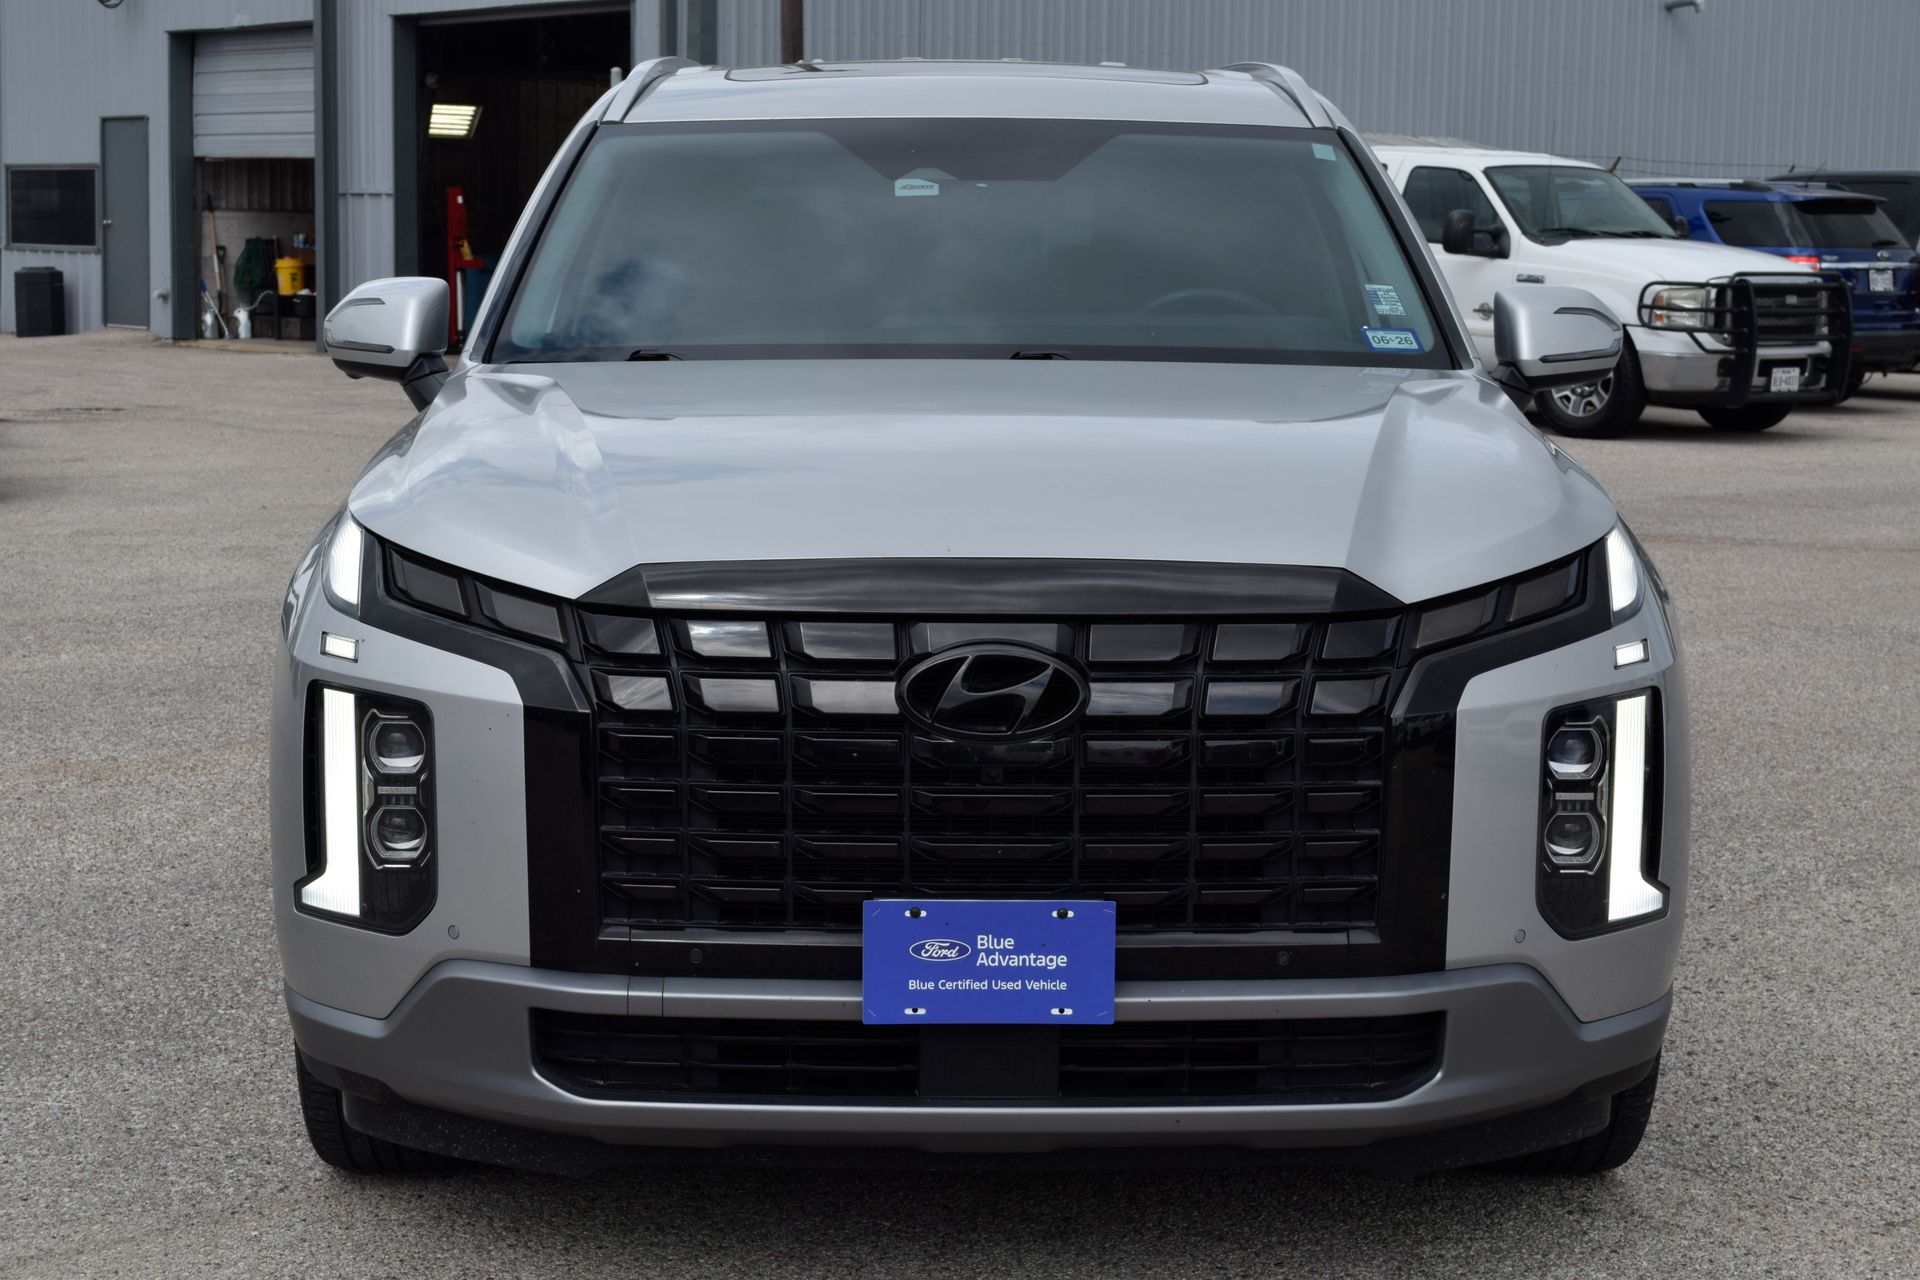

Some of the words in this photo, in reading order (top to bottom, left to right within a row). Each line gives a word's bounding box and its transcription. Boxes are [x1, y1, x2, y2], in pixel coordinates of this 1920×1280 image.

[921, 941, 960, 958] Ford
[976, 934, 1015, 949] Blue
[976, 951, 1068, 970] Advantage
[908, 979, 935, 990] Blue
[938, 979, 988, 990] Certified
[992, 979, 1022, 990] Used
[1025, 979, 1067, 990] Vehicle
